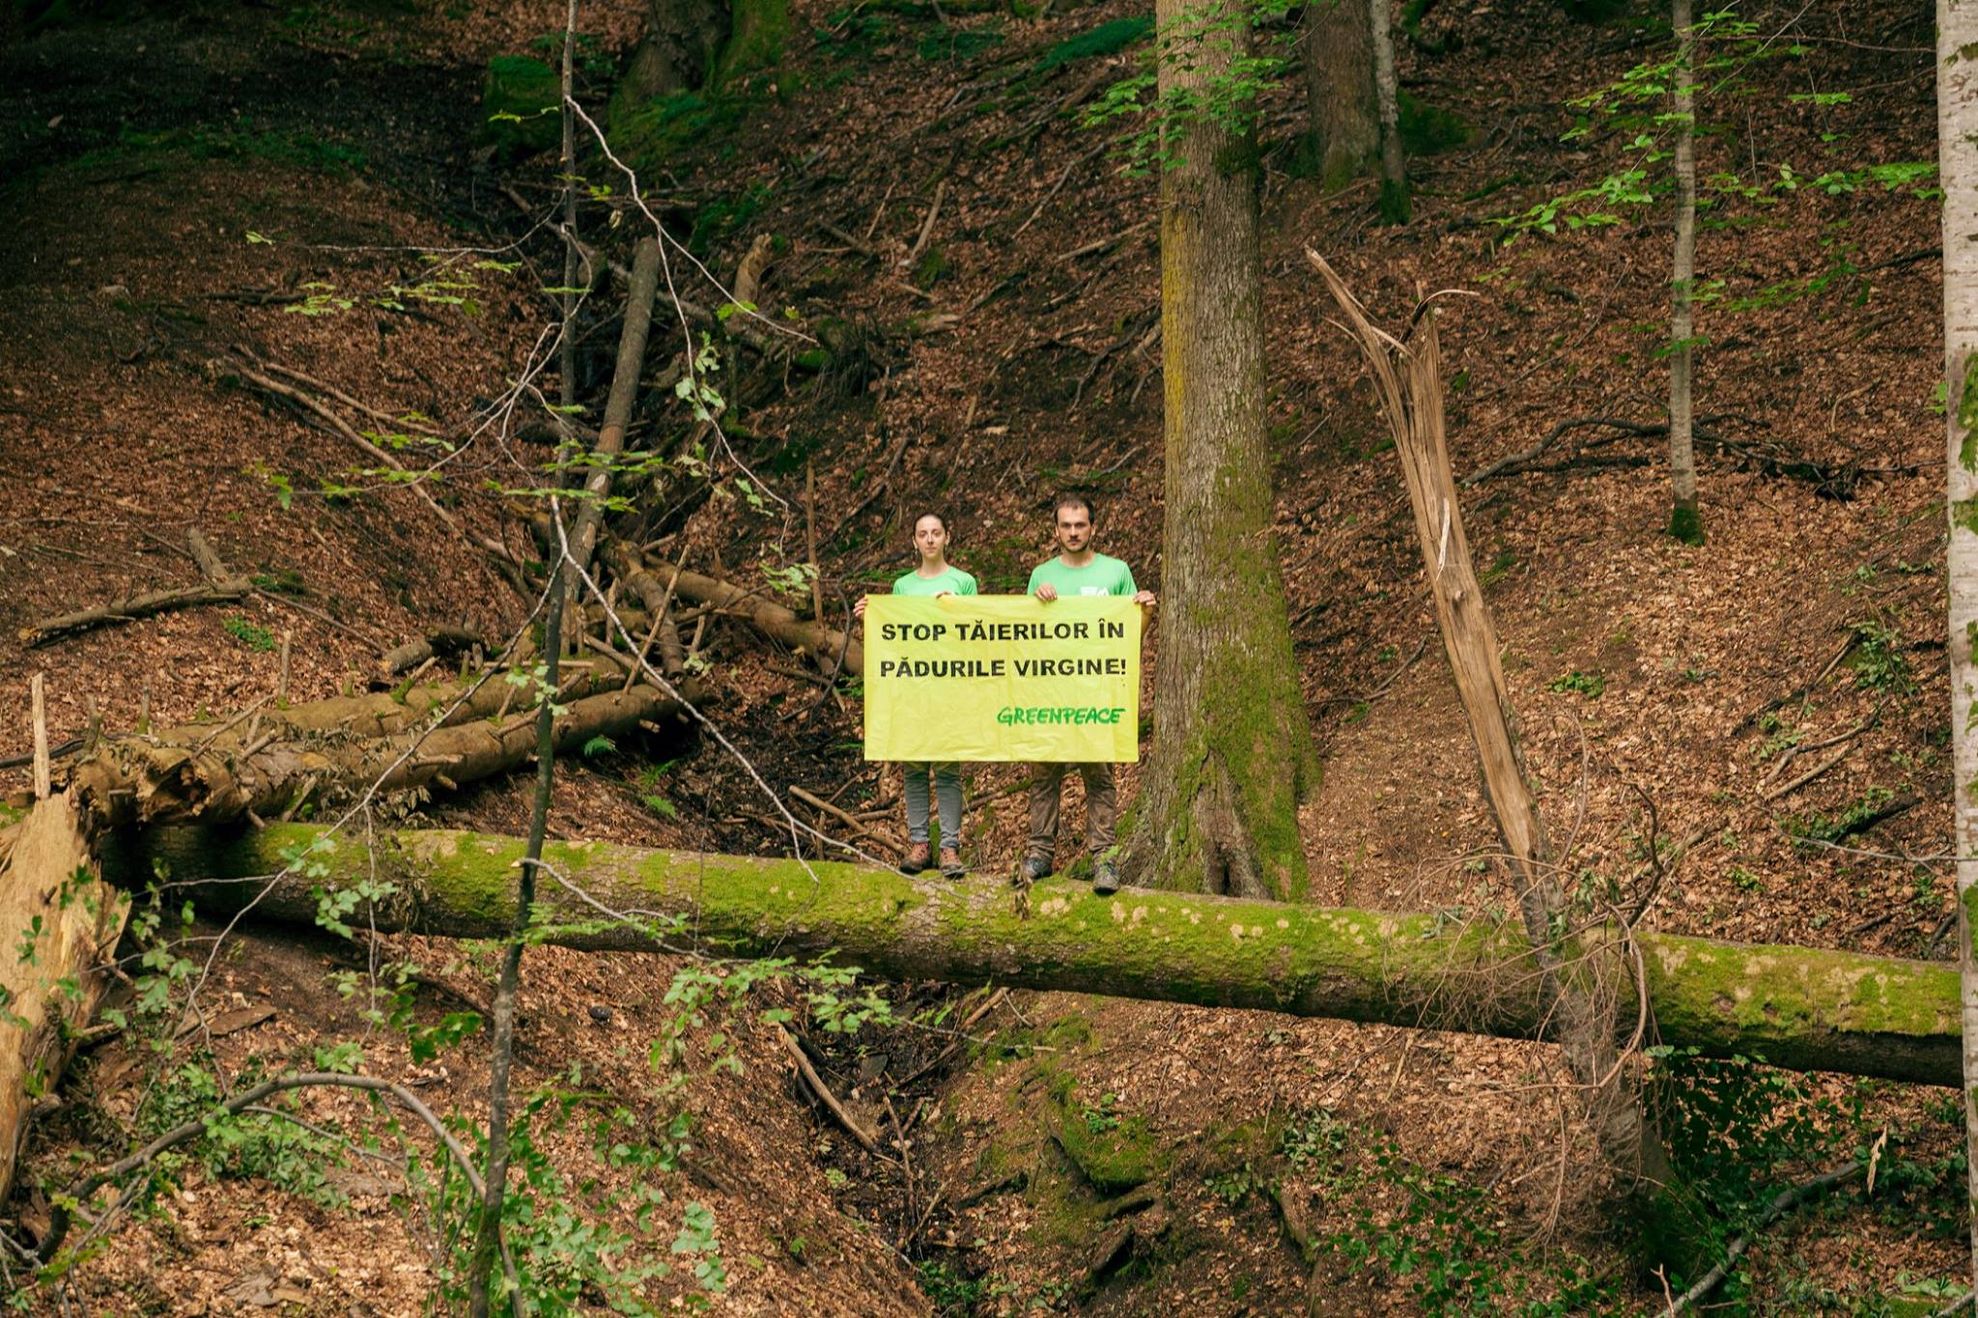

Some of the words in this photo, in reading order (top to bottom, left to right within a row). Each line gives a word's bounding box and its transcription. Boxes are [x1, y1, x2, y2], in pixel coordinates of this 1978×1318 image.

[882, 623, 947, 641] STOP
[955, 619, 1089, 641] TĂIERILOR
[1098, 618, 1124, 638] ÎN
[880, 657, 1005, 677] PĂDURILE
[1014, 658, 1126, 677] VIRGINE!
[997, 707, 1125, 726] GREENPEACE
